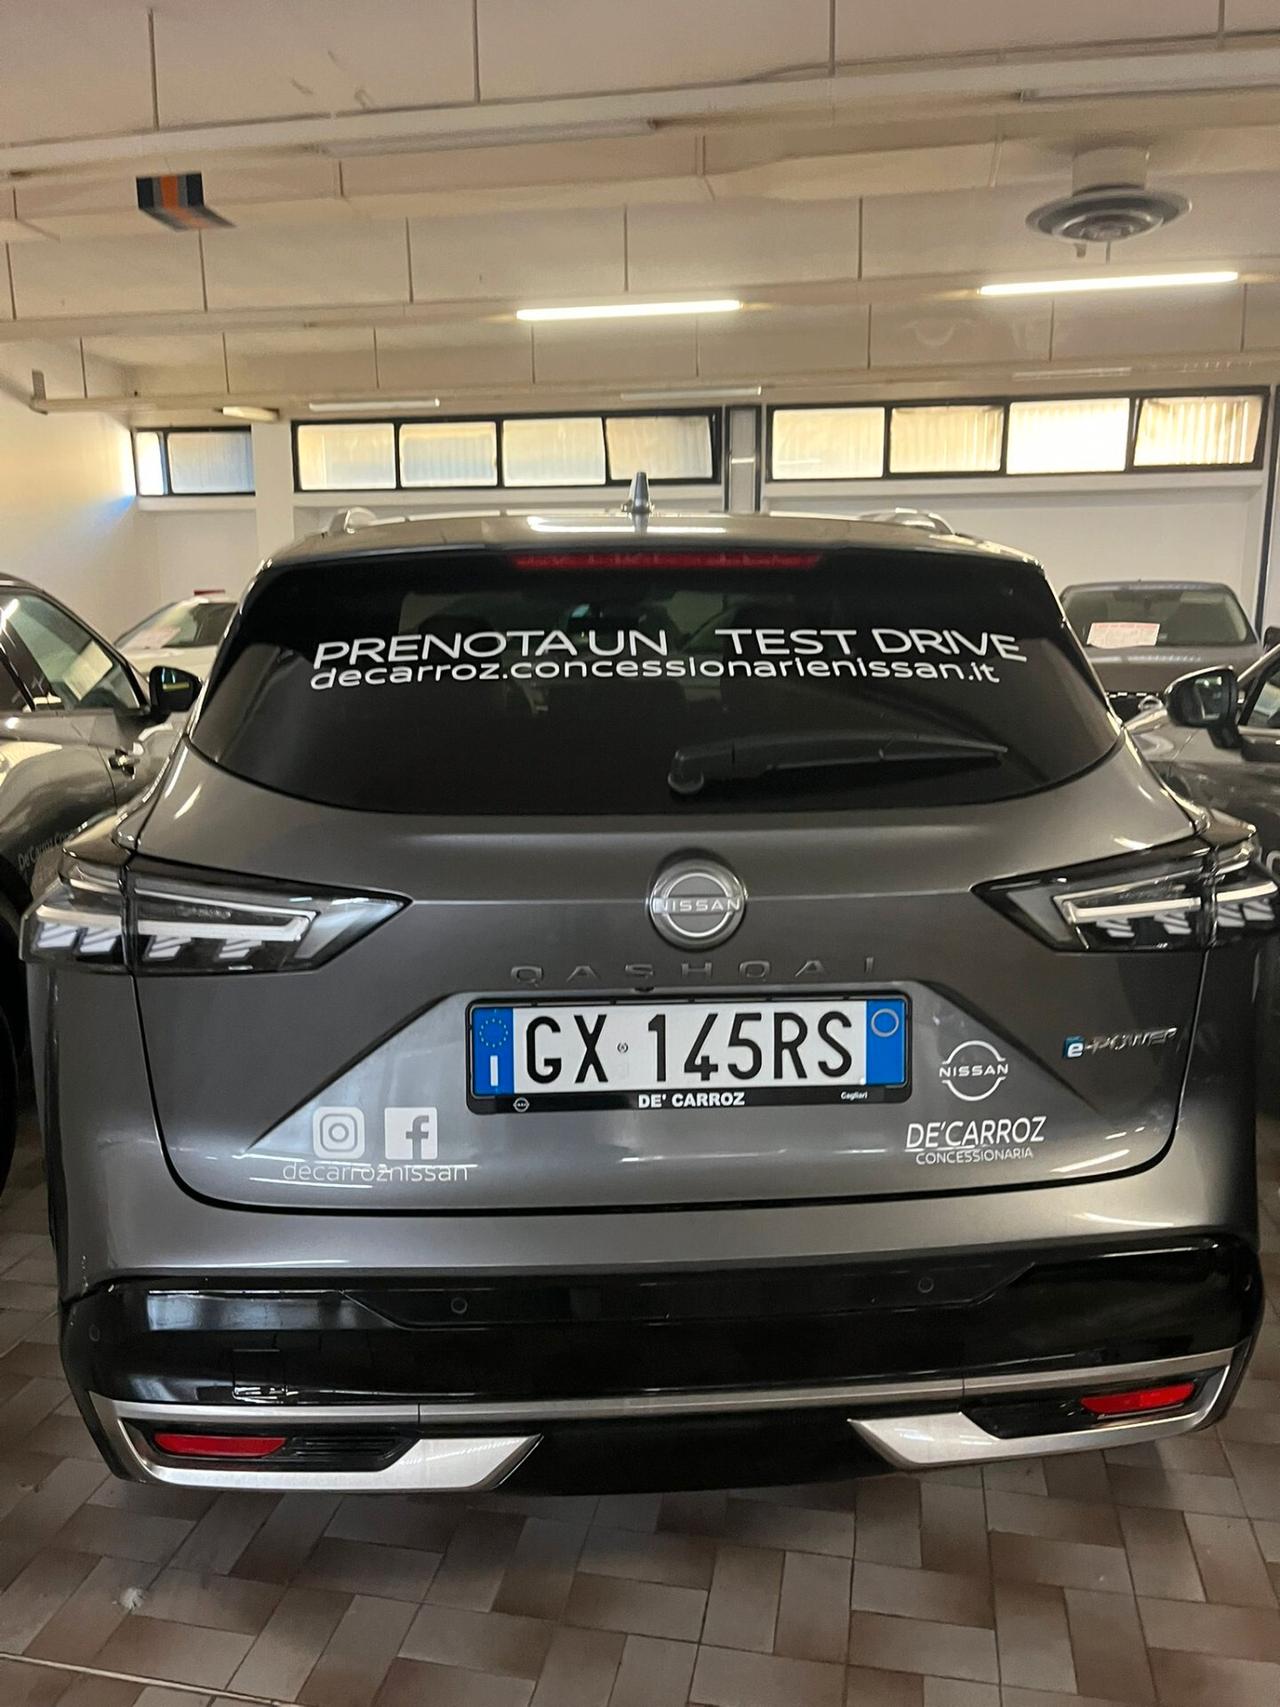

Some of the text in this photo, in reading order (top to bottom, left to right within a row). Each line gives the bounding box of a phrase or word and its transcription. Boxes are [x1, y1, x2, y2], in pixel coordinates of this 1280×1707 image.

[313, 628, 1027, 670] PRENOTA UN TEST DRIVE
[310, 657, 1000, 690] decarroz.concessionarienissan.it
[652, 898, 741, 912] NISSAN
[510, 957, 875, 987] QASHQAI
[526, 1011, 853, 1084] GX 145RS
[939, 1063, 1009, 1077] NISSAN
[671, 1091, 746, 1108] CARROZ
[905, 1115, 1047, 1149] DE'CARROZ
[915, 1147, 1034, 1165] CONCESSIONARIA
[282, 1161, 468, 1182] decarroznissan
